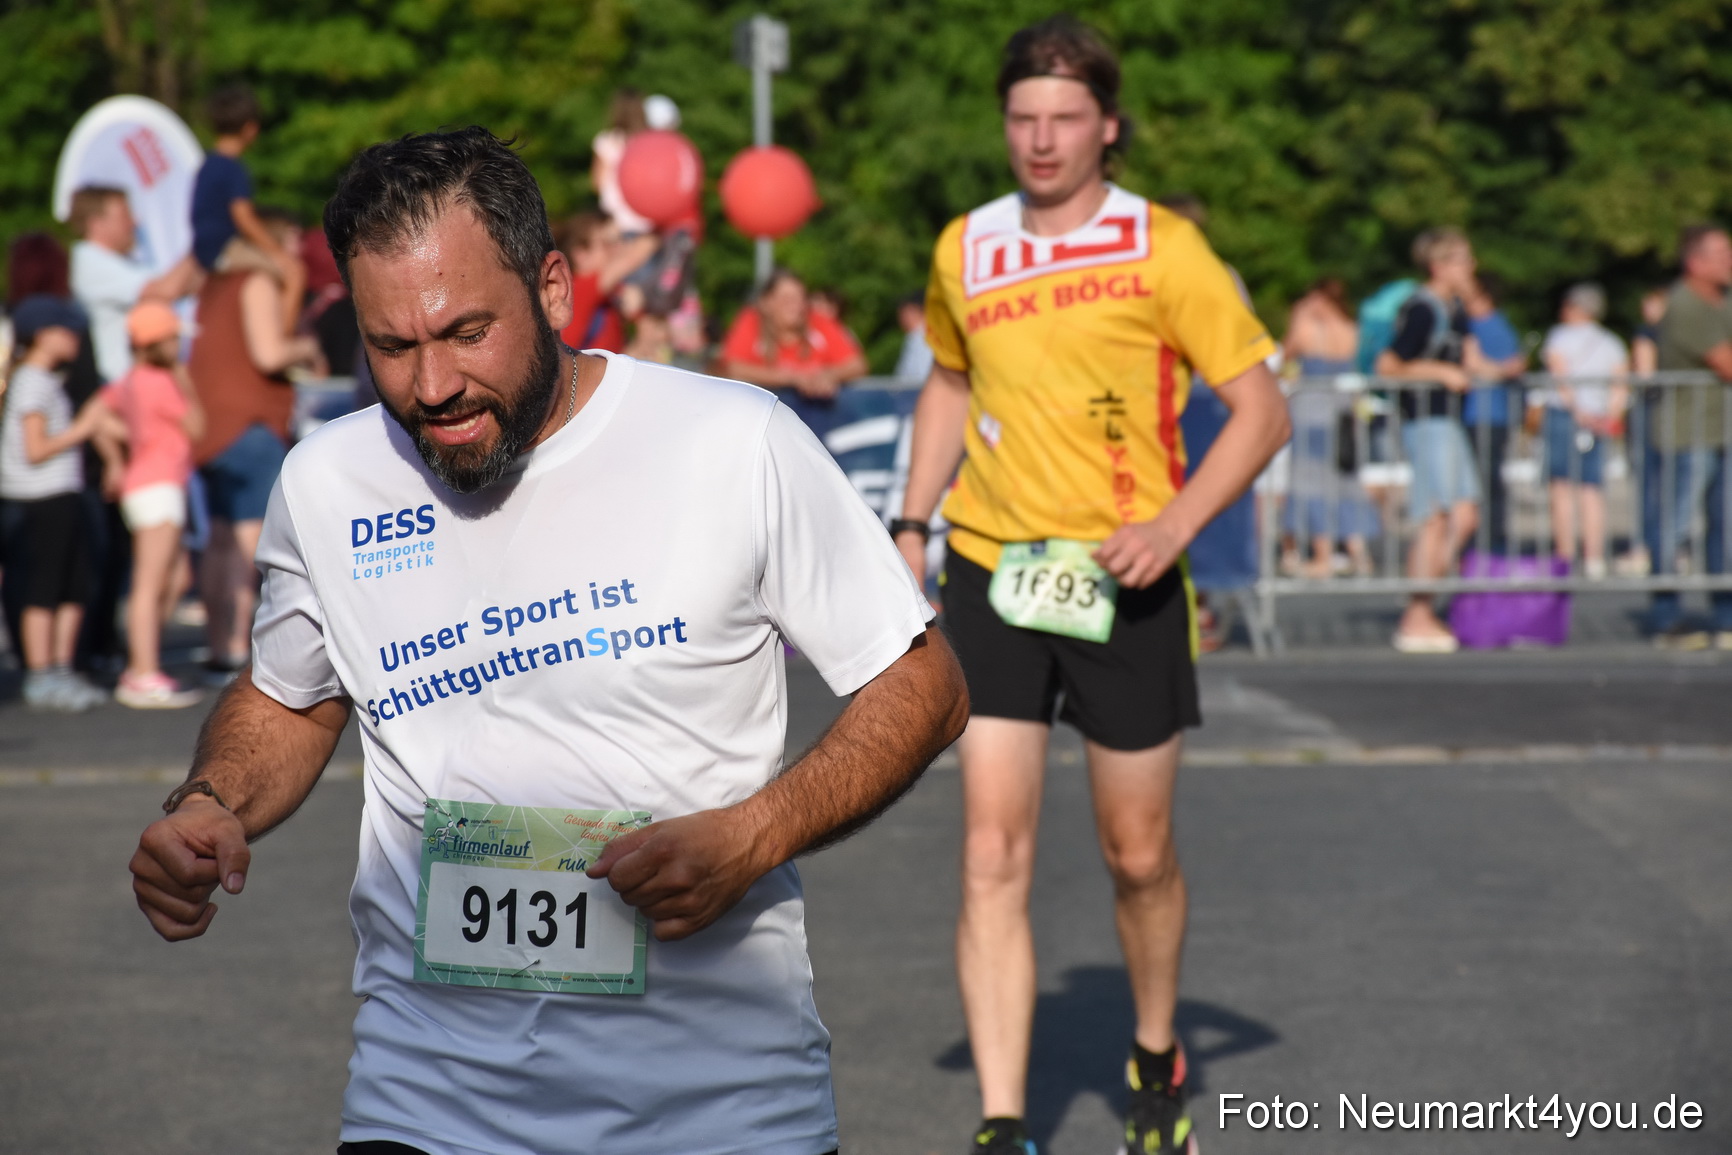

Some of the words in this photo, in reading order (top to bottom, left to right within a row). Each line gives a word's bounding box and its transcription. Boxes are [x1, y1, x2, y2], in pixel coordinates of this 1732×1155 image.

[967, 292, 1039, 335] MAX
[1054, 273, 1152, 308] BÖGL
[351, 504, 436, 548] DESS
[353, 540, 435, 566] Transporte
[353, 554, 434, 580] Logistik
[1012, 567, 1098, 608] 1693
[380, 620, 470, 673] Unser
[481, 588, 579, 636] Sport
[589, 578, 638, 610] ist
[564, 814, 605, 830] Gesunde
[453, 834, 531, 857] firmenlauf
[581, 829, 610, 843] laufen
[452, 852, 485, 862] chiemgau
[558, 857, 587, 872] run
[461, 885, 588, 949] 9131
